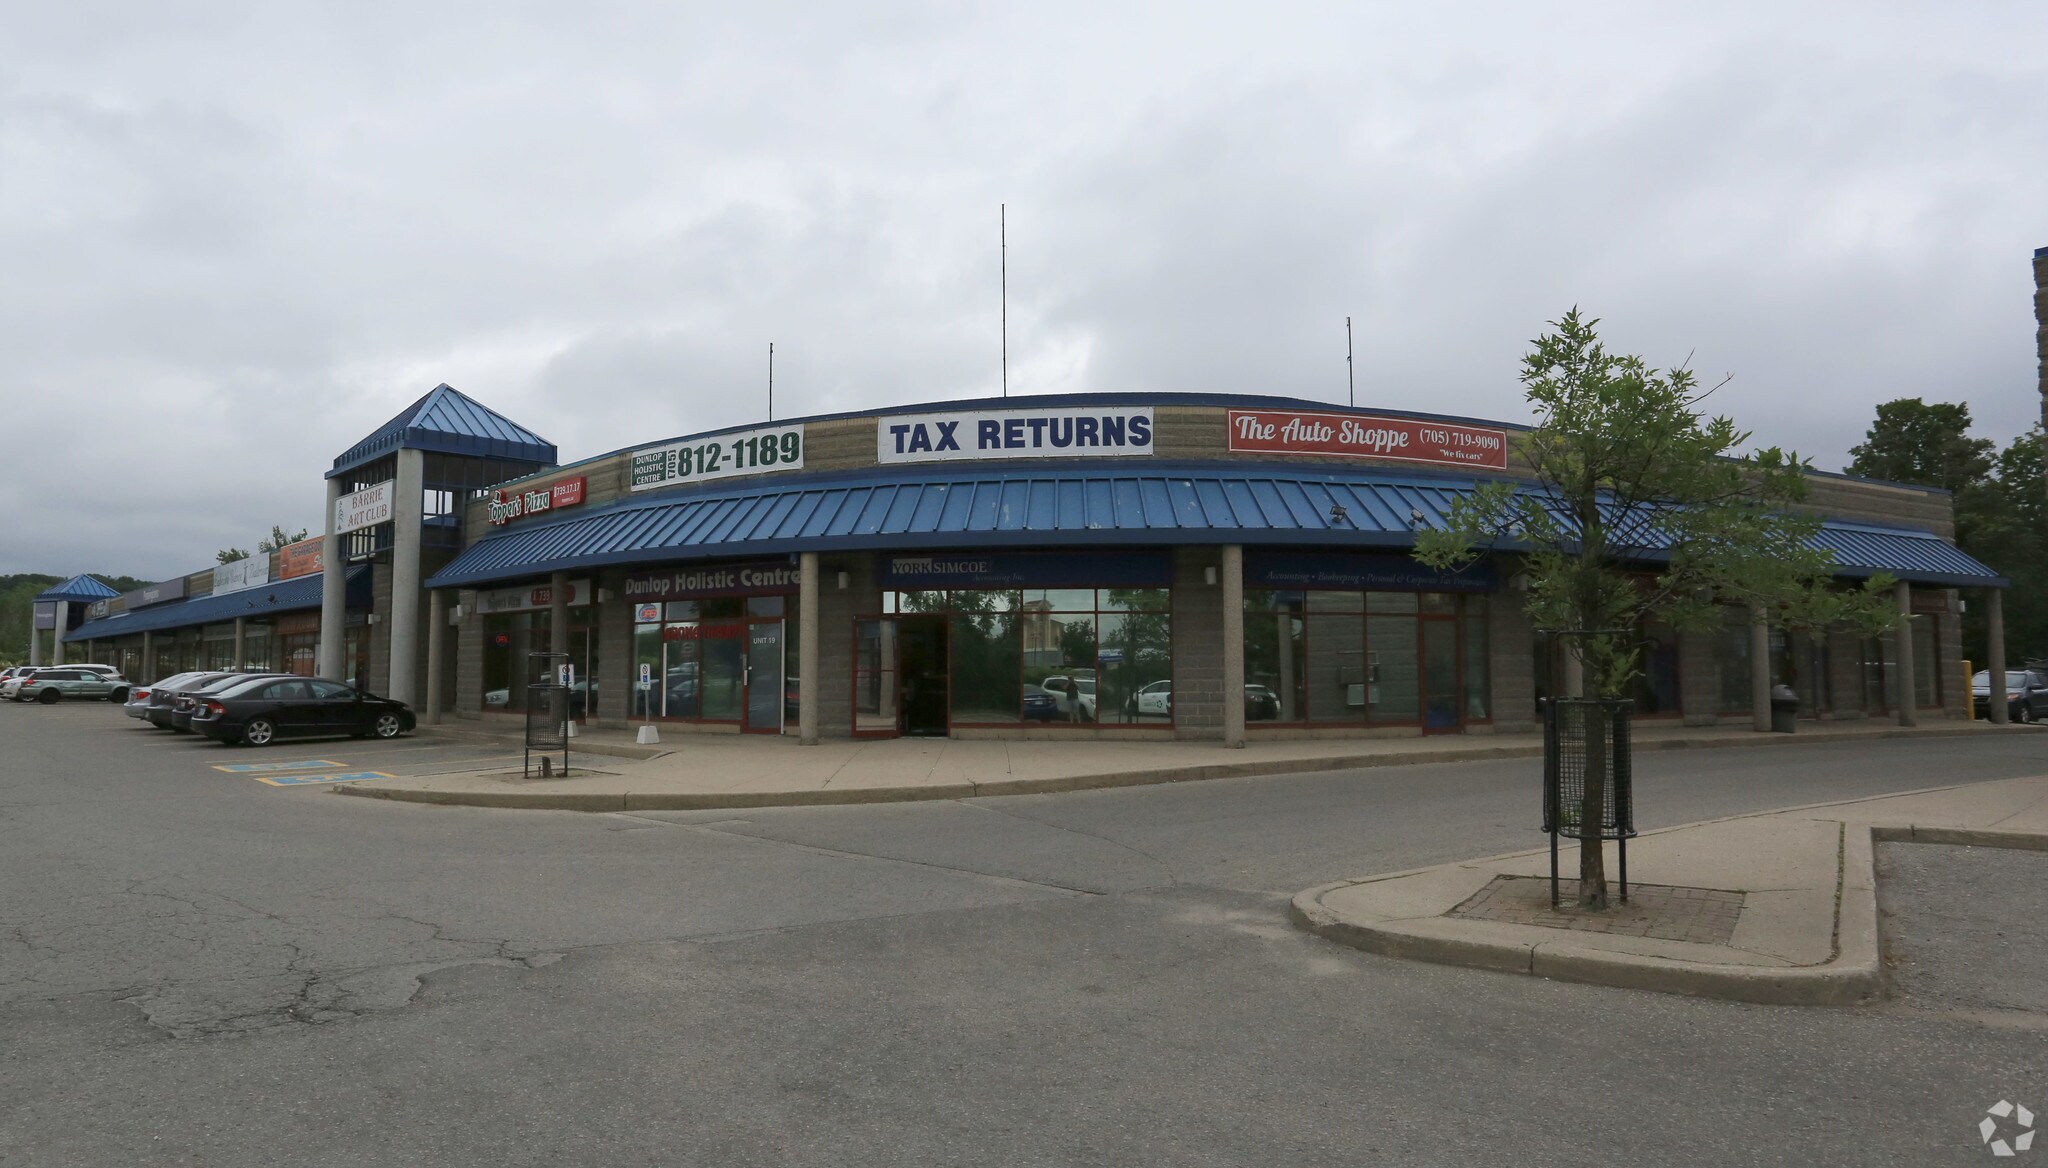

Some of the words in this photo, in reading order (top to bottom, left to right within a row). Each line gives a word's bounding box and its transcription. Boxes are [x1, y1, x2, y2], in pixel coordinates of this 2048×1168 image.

[890, 421, 960, 454] TAX
[977, 415, 1151, 450] RETURNS
[1235, 415, 1277, 440] The
[1280, 418, 1336, 444] Auto
[1338, 420, 1409, 452] Shoppe
[1419, 427, 1450, 446] (705)
[1452, 432, 1500, 451] 719-9090
[636, 452, 663, 465] DUNLOP
[677, 431, 800, 477] 812-1189
[1439, 448, 1455, 458] "We
[1455, 449, 1465, 459] fix
[1465, 452, 1483, 461] cars"
[634, 462, 664, 476] HOLISTIC
[636, 473, 661, 486] CENTRE
[352, 487, 383, 509] BARRIE
[488, 495, 522, 525] Topper's
[524, 491, 550, 514] Pizza
[348, 511, 365, 527] ART
[365, 503, 387, 522] CLUB
[892, 561, 932, 574] YORK
[933, 561, 988, 574] SIMCOE
[1266, 571, 1310, 583] Accounting
[625, 578, 670, 596] Dunlop
[675, 570, 735, 593] Holistic
[740, 568, 800, 587] Centre
[753, 637, 767, 645] UNIT
[768, 637, 776, 645] 19
